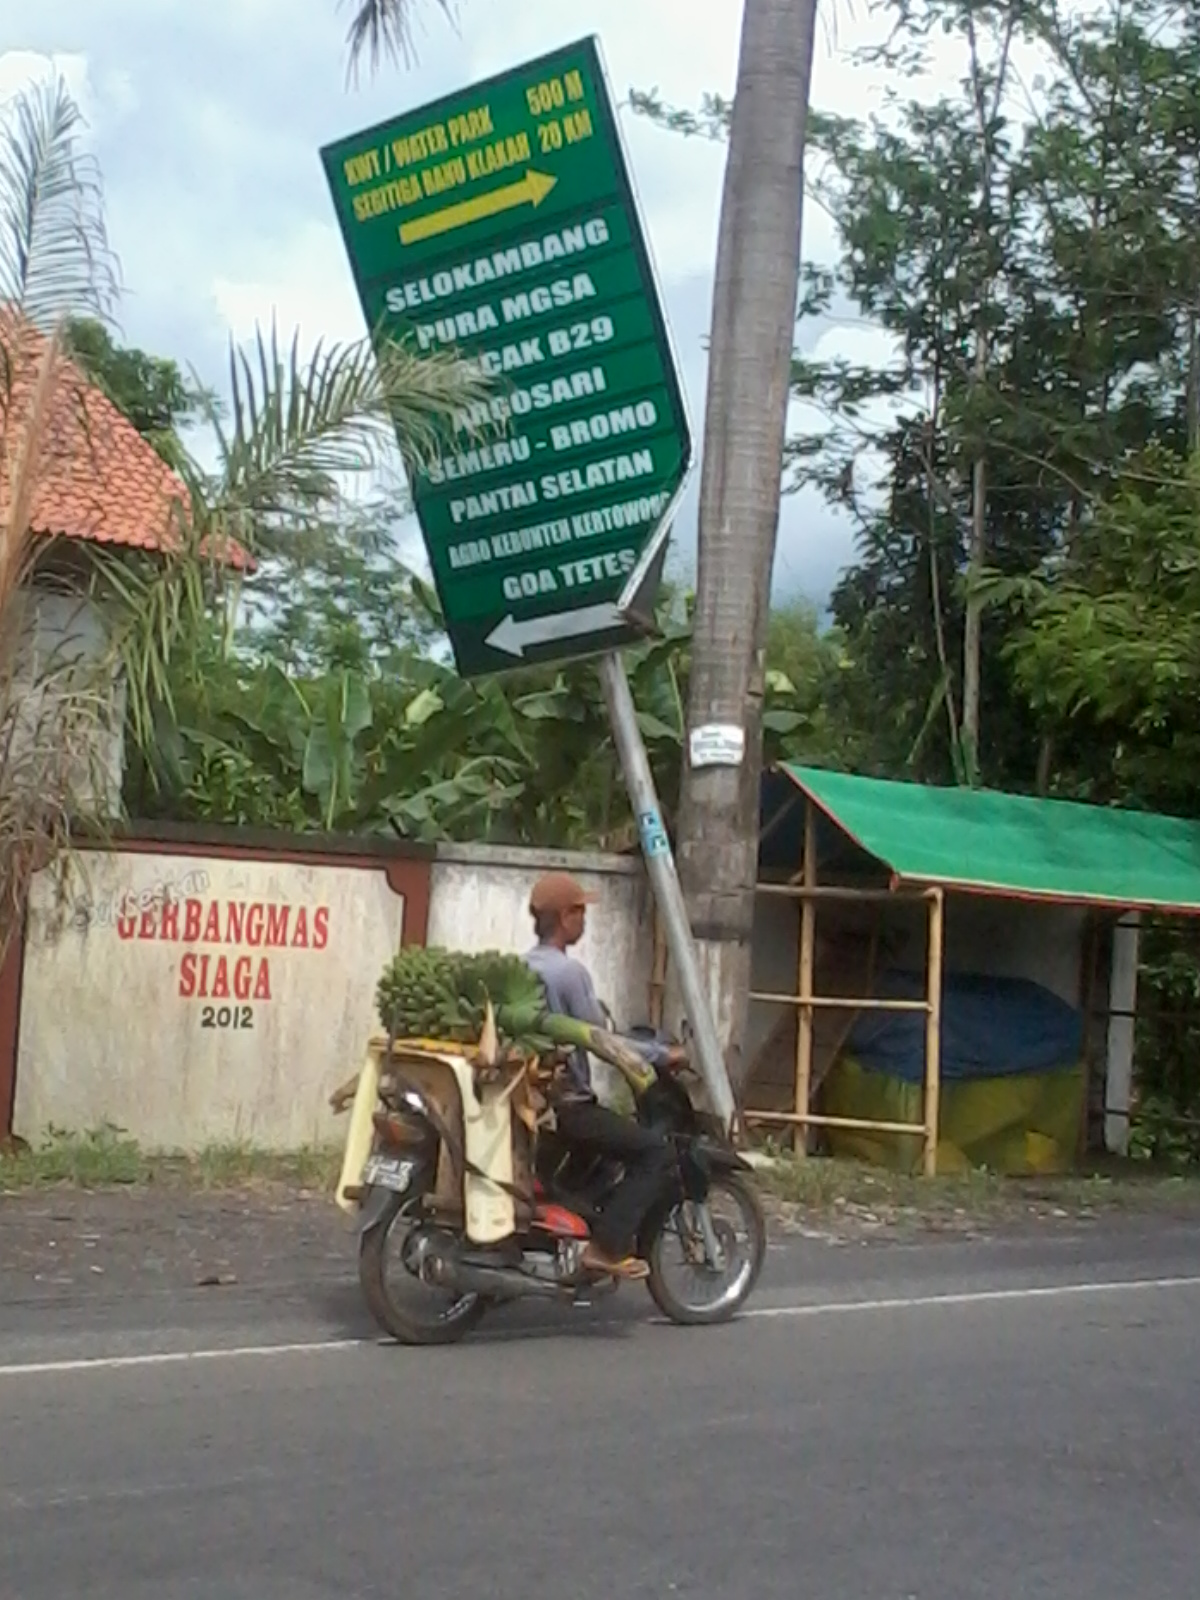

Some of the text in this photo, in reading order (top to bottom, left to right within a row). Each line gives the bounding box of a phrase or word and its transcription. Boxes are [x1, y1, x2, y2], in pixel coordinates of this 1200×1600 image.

[391, 123, 449, 168] WATER
[447, 103, 494, 147] PARK
[525, 78, 565, 116] 500
[537, 120, 563, 153] 20
[562, 108, 593, 144] KM
[385, 217, 610, 314] SELOKAMBANG
[416, 273, 597, 350] PURA MGSA
[547, 315, 615, 357] B29
[428, 435, 531, 484] SEMERU
[550, 399, 658, 452] BROMO
[449, 449, 654, 524] PANTAI SELATAN
[503, 549, 635, 600] GOA TETES
[116, 898, 330, 951] GERBANGMAS
[179, 952, 272, 1001] SIAGA
[201, 1005, 254, 1030] 2012
